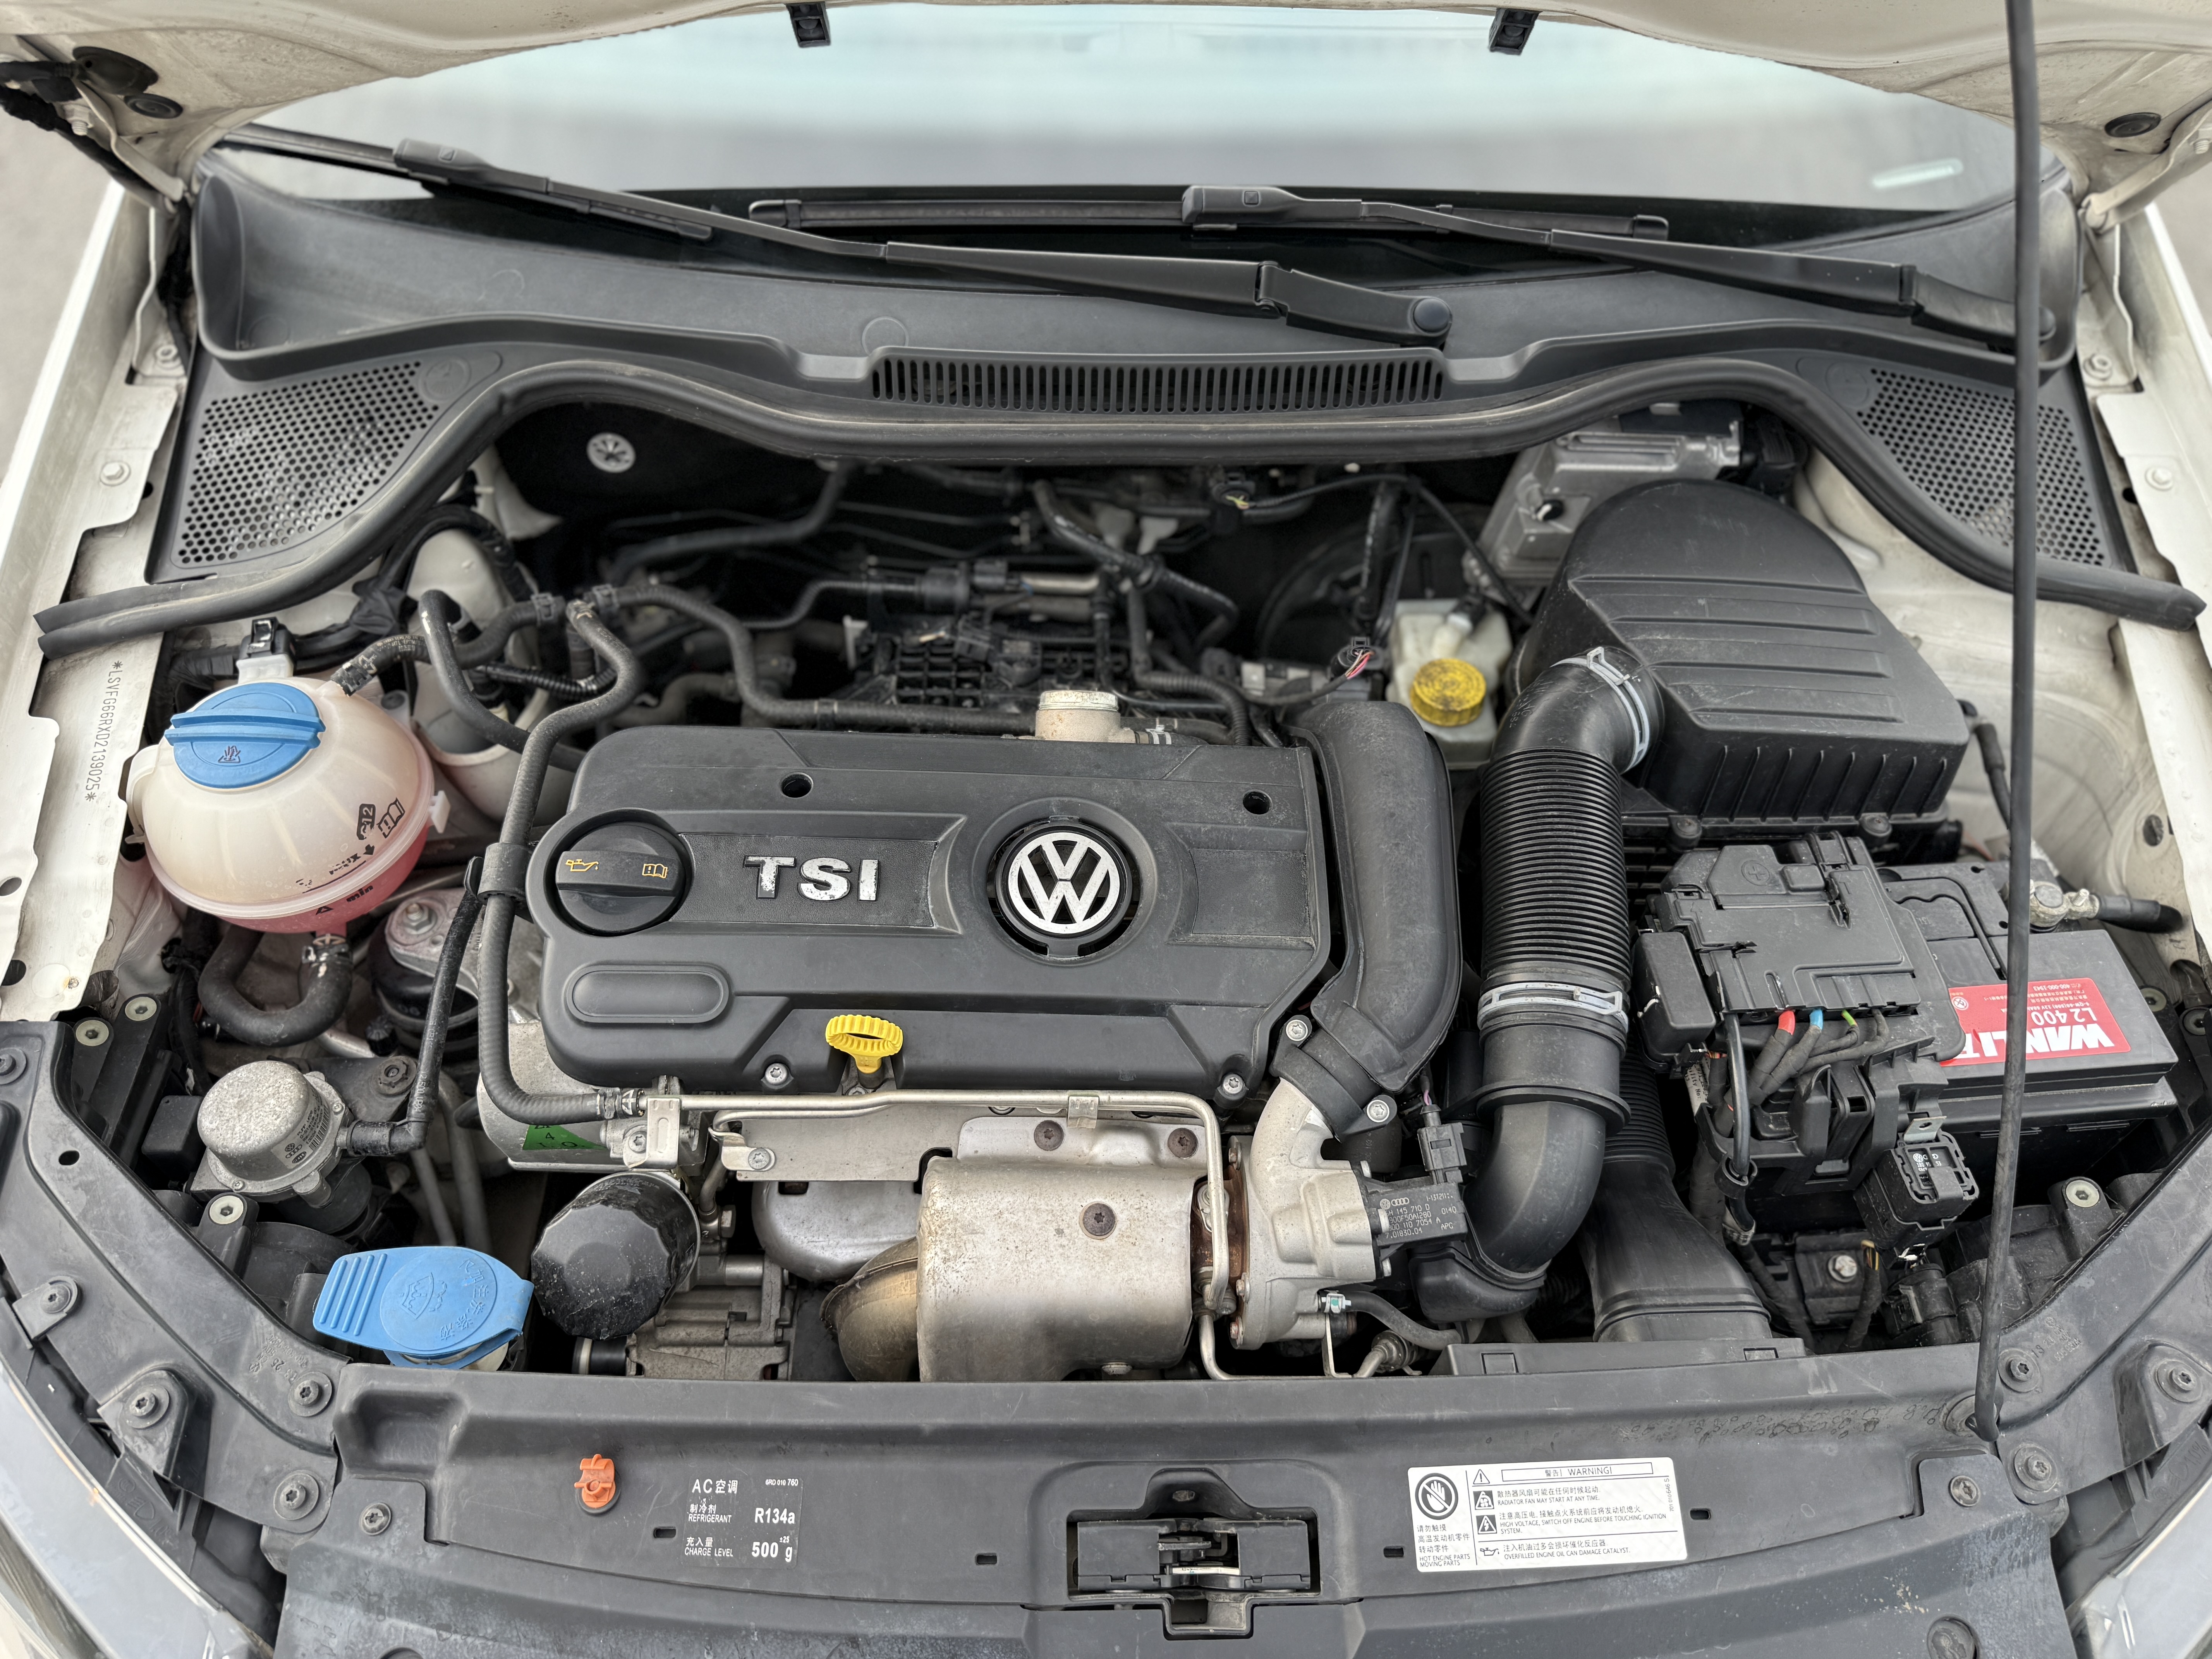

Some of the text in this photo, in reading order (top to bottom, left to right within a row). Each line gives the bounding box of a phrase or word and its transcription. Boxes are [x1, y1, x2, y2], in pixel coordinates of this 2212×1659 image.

[744, 855, 881, 902] TSI
[346, 885, 374, 902] min
[2031, 1007, 2097, 1026] L2 400
[1416, 1218, 1432, 1226] 7054
[690, 1503, 716, 1514] 制冷剂
[689, 1514, 732, 1523] REFRIGERANT
[754, 1508, 795, 1524] R134a
[1417, 1524, 1446, 1532] 请勿触摸
[686, 1536, 714, 1548] 充入量
[1418, 1533, 1470, 1543] 高温发动机零件
[685, 1547, 733, 1557] CHARGE LEVEL
[752, 1542, 793, 1562] 500 g
[1419, 1544, 1449, 1553] 转动零件
